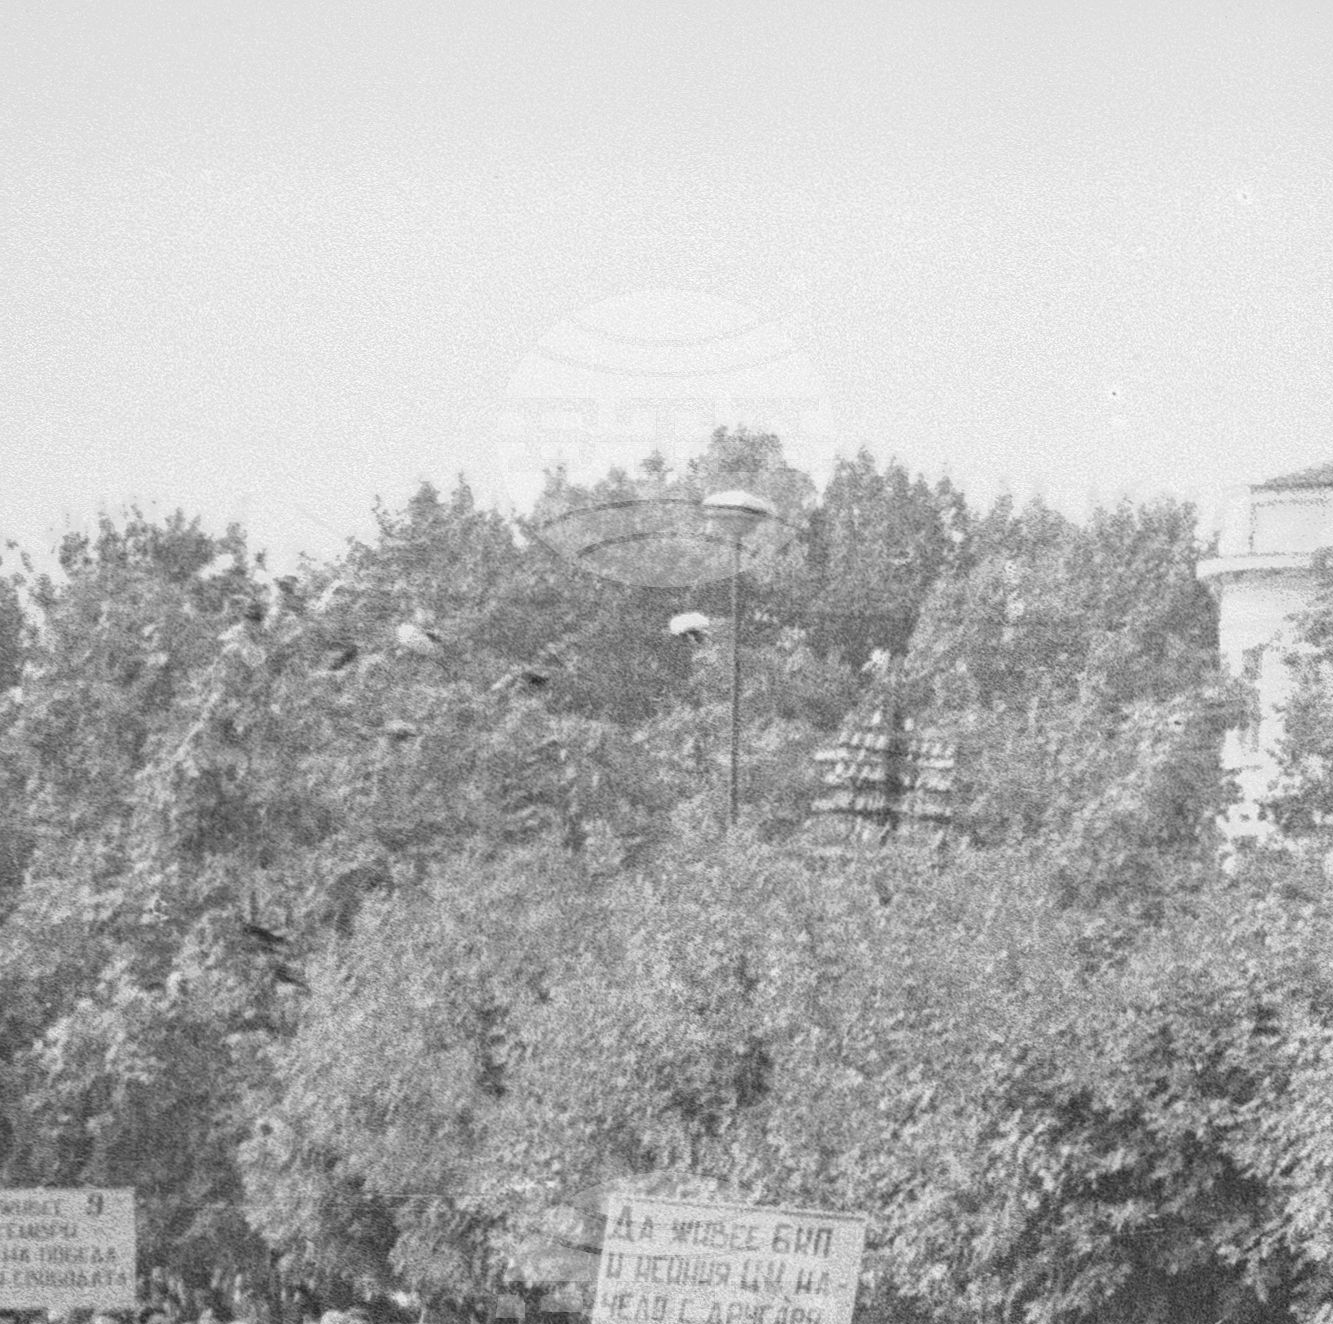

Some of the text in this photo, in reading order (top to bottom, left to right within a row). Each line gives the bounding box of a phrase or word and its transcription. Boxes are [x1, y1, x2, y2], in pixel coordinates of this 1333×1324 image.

[609, 1205, 654, 1243] ДА
[772, 1223, 834, 1258] БКП
[606, 1253, 623, 1279] И
[678, 1298, 695, 1324] С
